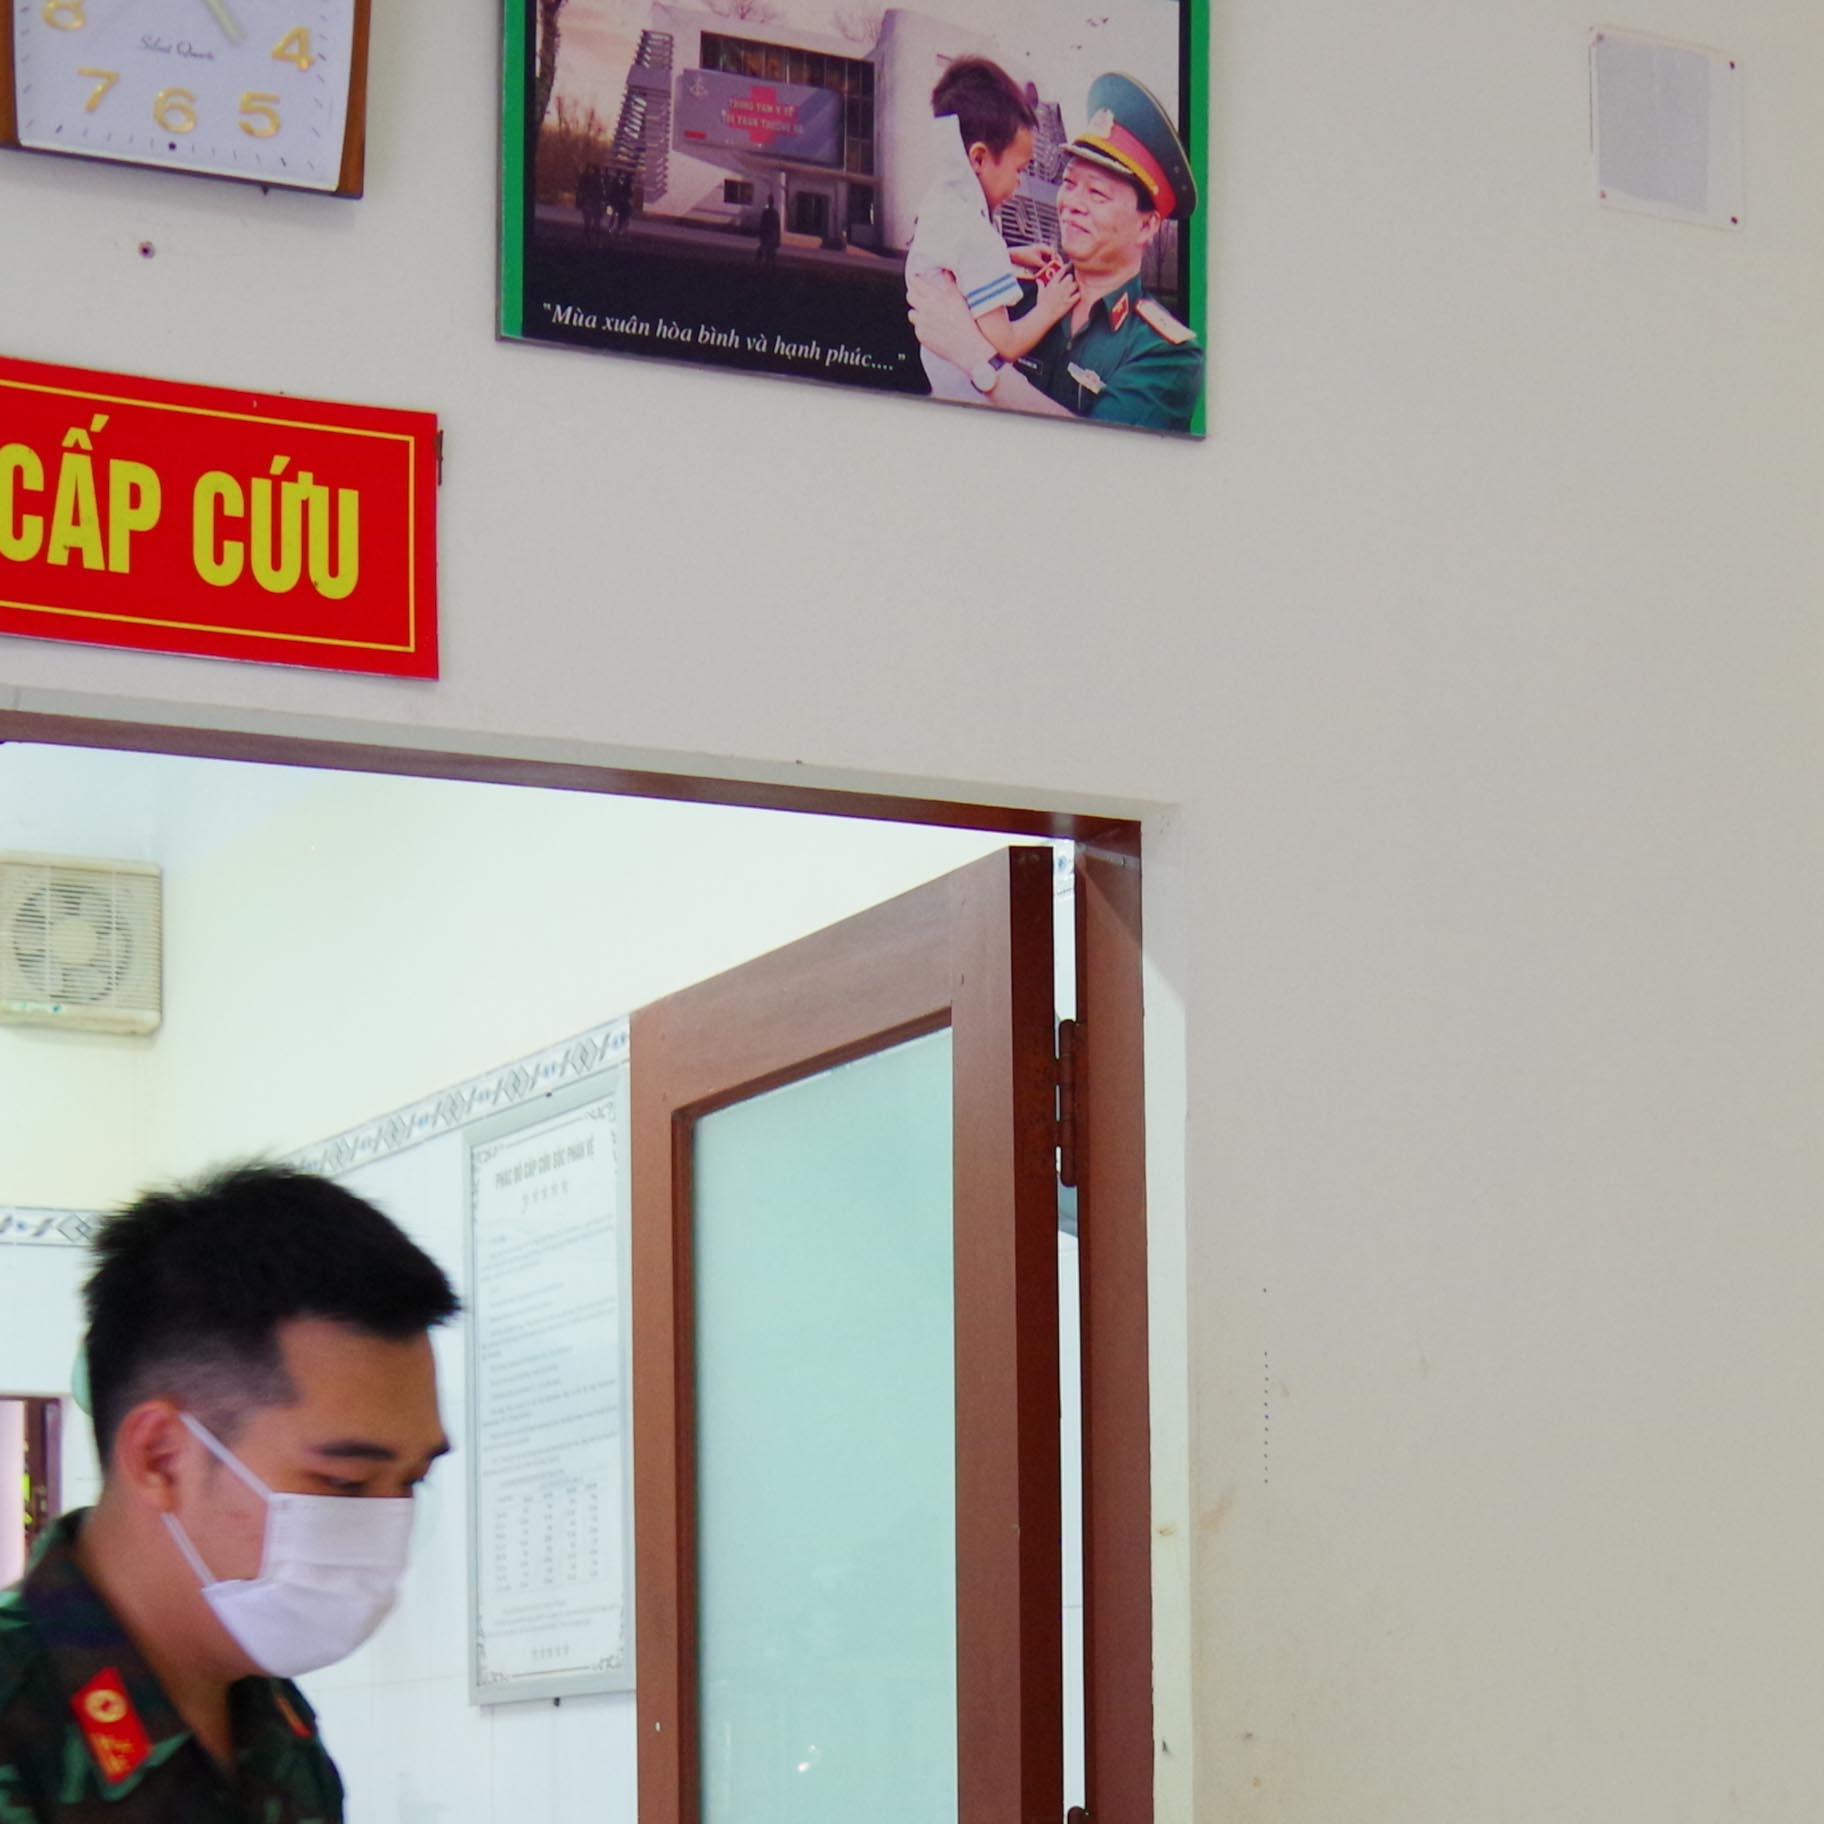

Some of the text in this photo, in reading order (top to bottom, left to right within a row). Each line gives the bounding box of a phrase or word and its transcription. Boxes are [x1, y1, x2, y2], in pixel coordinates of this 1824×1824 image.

[272, 26, 315, 72] 4
[77, 66, 281, 138] 7 6 5
[602, 315, 650, 337] xuân
[655, 318, 692, 342] hòa
[698, 324, 740, 350] bình
[746, 332, 768, 353] và
[774, 335, 821, 360] hạnh
[192, 455, 359, 599] CỨU
